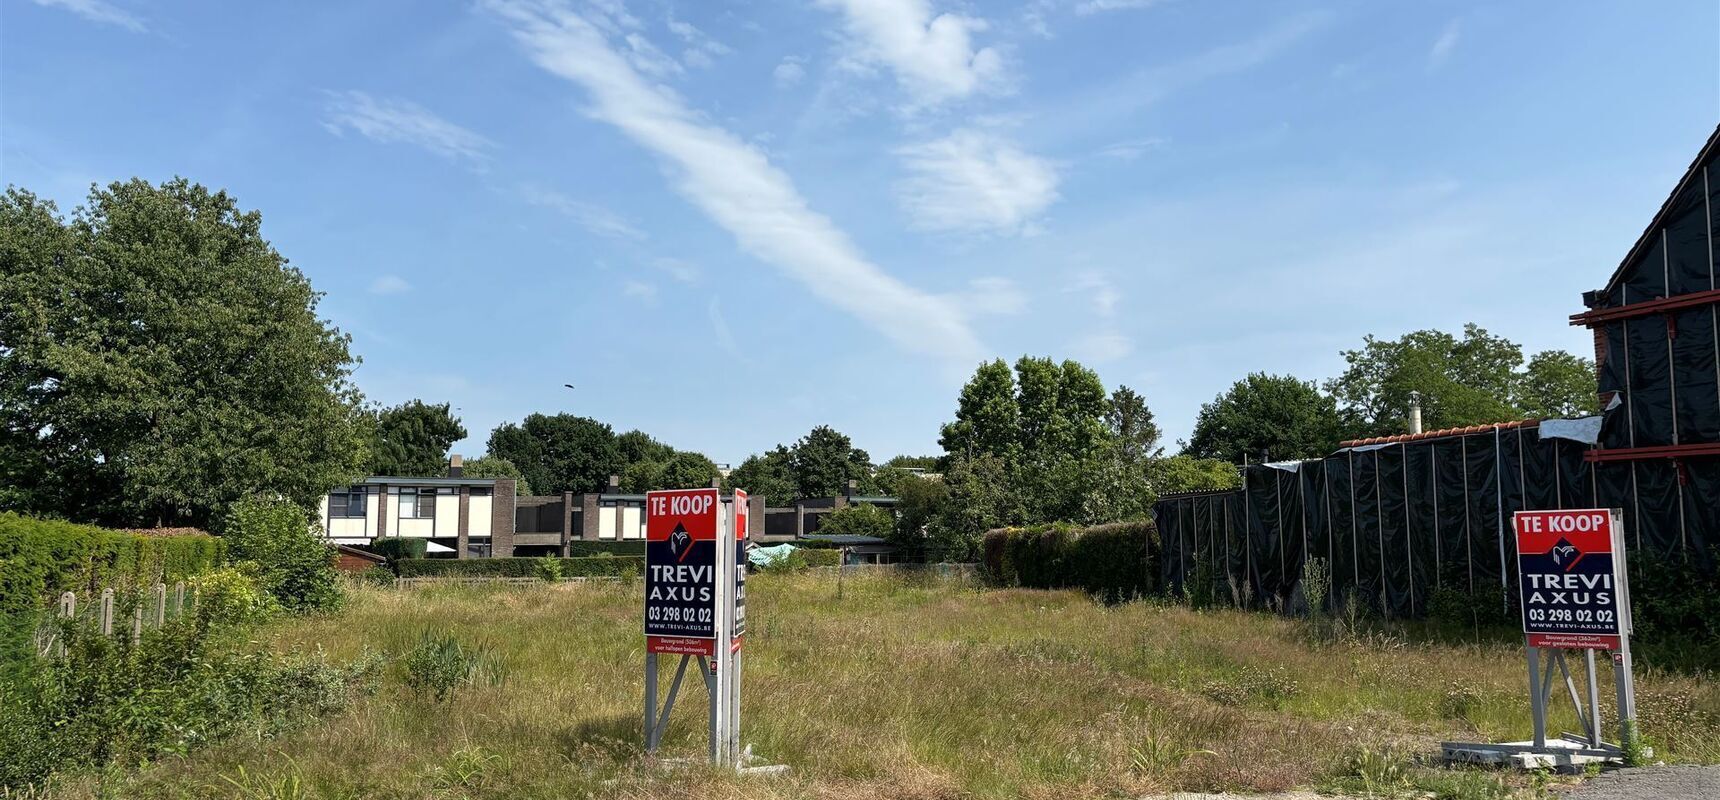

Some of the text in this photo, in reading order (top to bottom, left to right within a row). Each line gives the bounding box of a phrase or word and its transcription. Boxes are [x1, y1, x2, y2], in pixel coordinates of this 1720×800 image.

[650, 496, 666, 516] TE
[671, 495, 713, 515] KOOP
[1521, 515, 1604, 533] TE KOOP
[651, 565, 713, 583] TREVI
[1527, 574, 1611, 589] TREVI
[649, 586, 711, 602] AXUS
[1528, 592, 1611, 605] AXUS
[649, 606, 711, 622] 03 298 02 02
[1529, 609, 1614, 622] 03 298 02 02
[648, 623, 712, 631] WWW.TREVI-AXUS.BE
